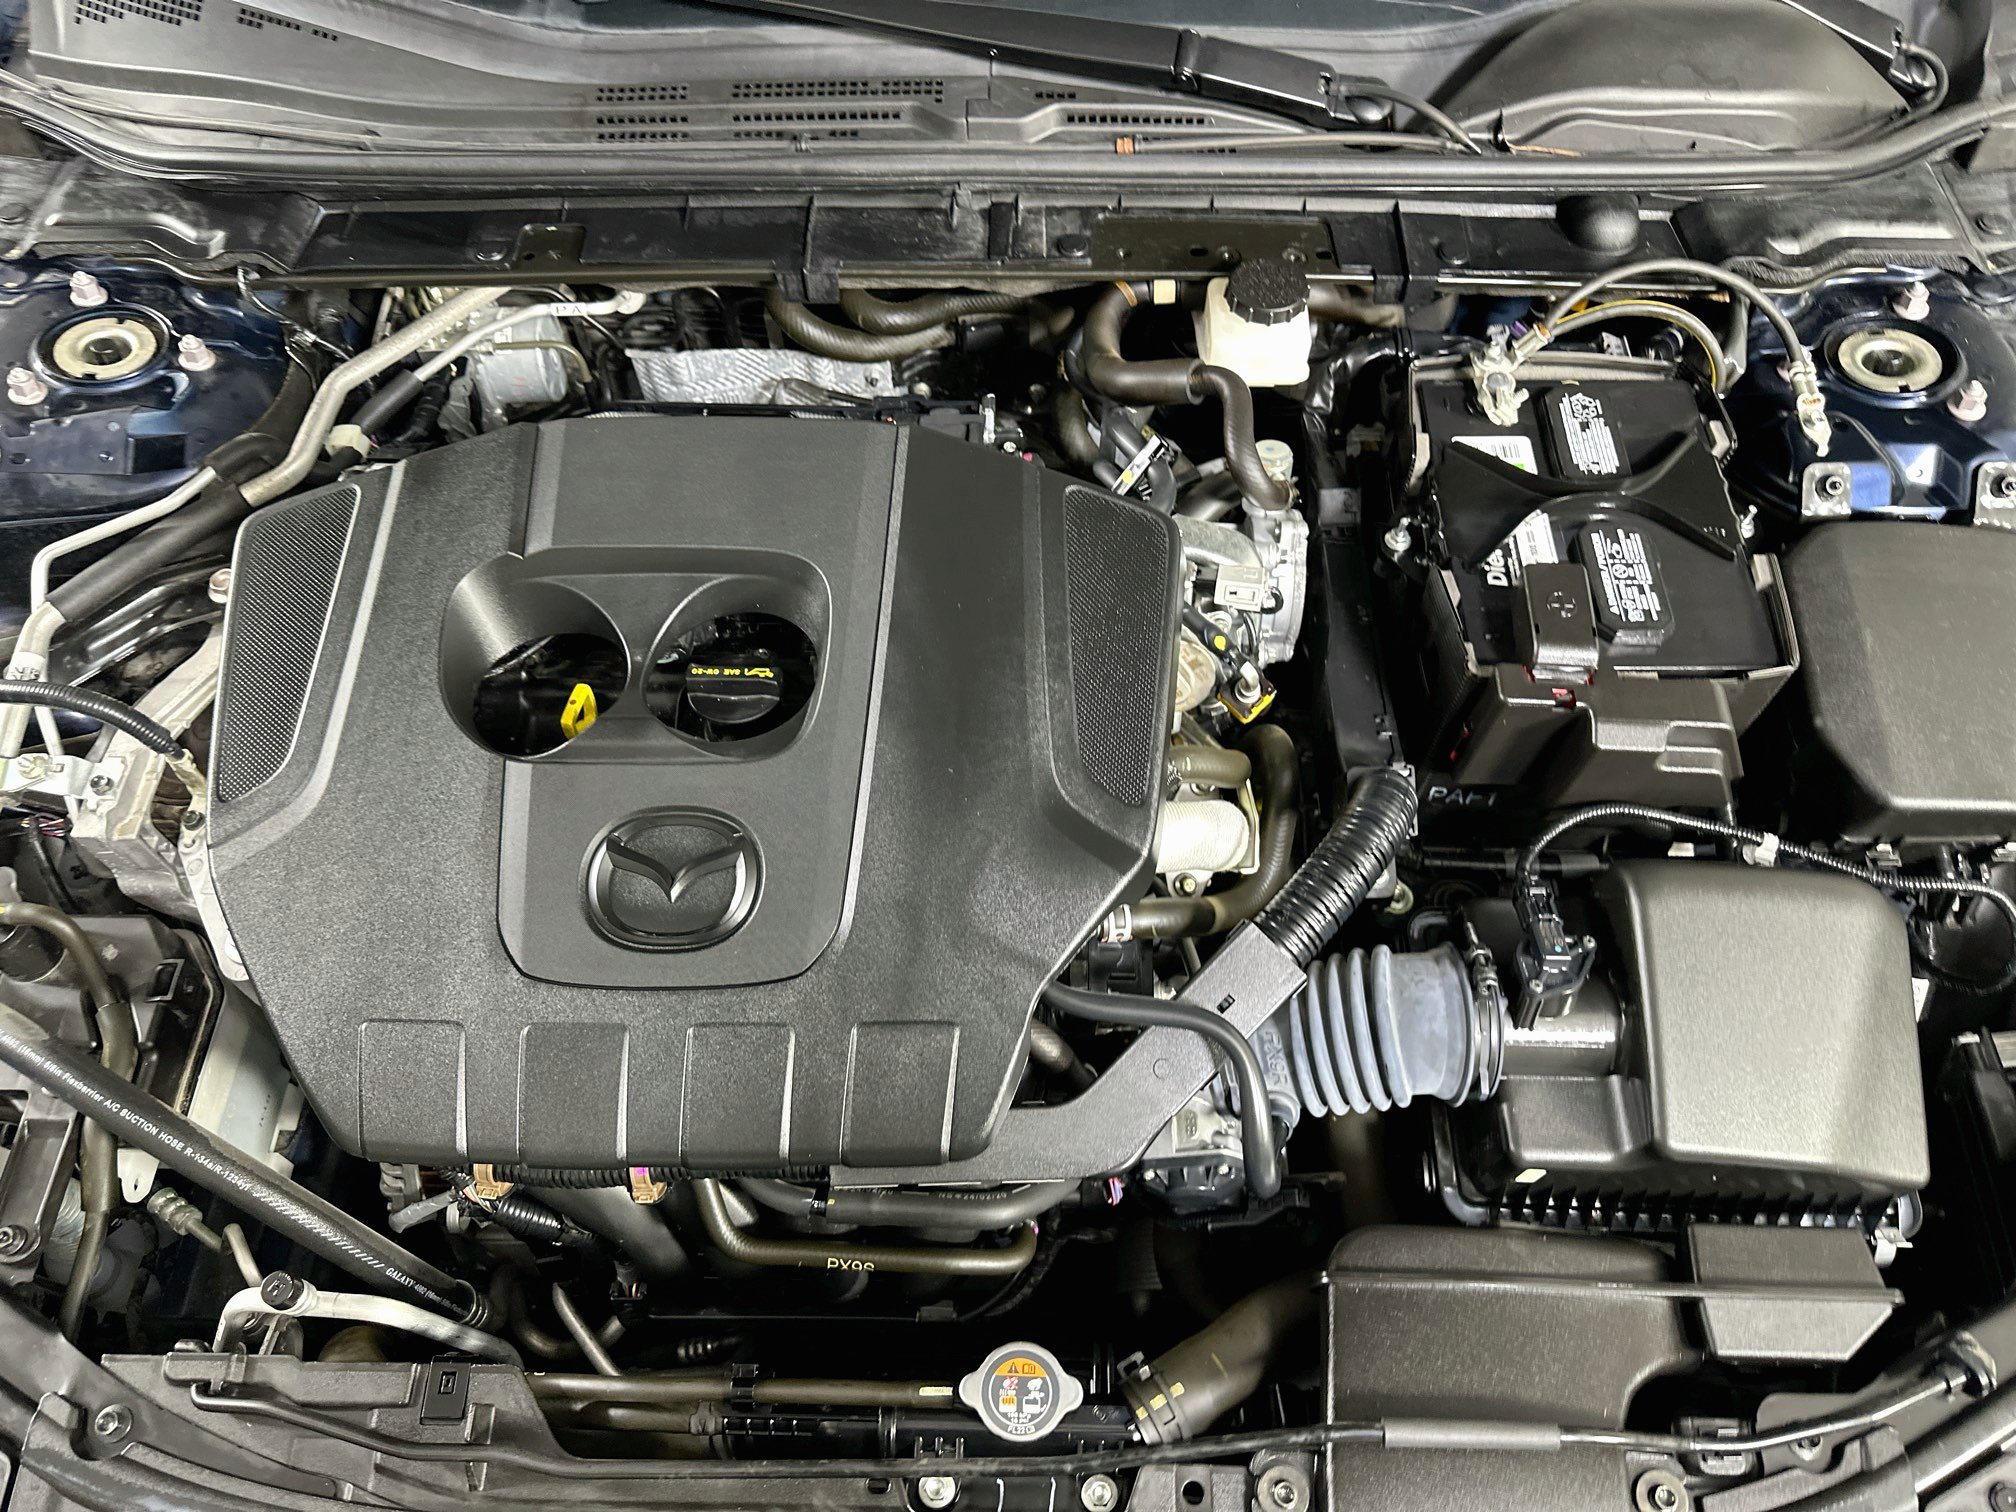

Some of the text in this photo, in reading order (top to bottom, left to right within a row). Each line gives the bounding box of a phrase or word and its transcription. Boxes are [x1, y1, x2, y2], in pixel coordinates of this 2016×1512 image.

[62, 1072, 105, 1102] Flexbarrier
[103, 1098, 121, 1112] A/C
[120, 1108, 160, 1136] SUCTION
[158, 1131, 185, 1151] HOSE
[385, 1267, 416, 1288] GALAXY
